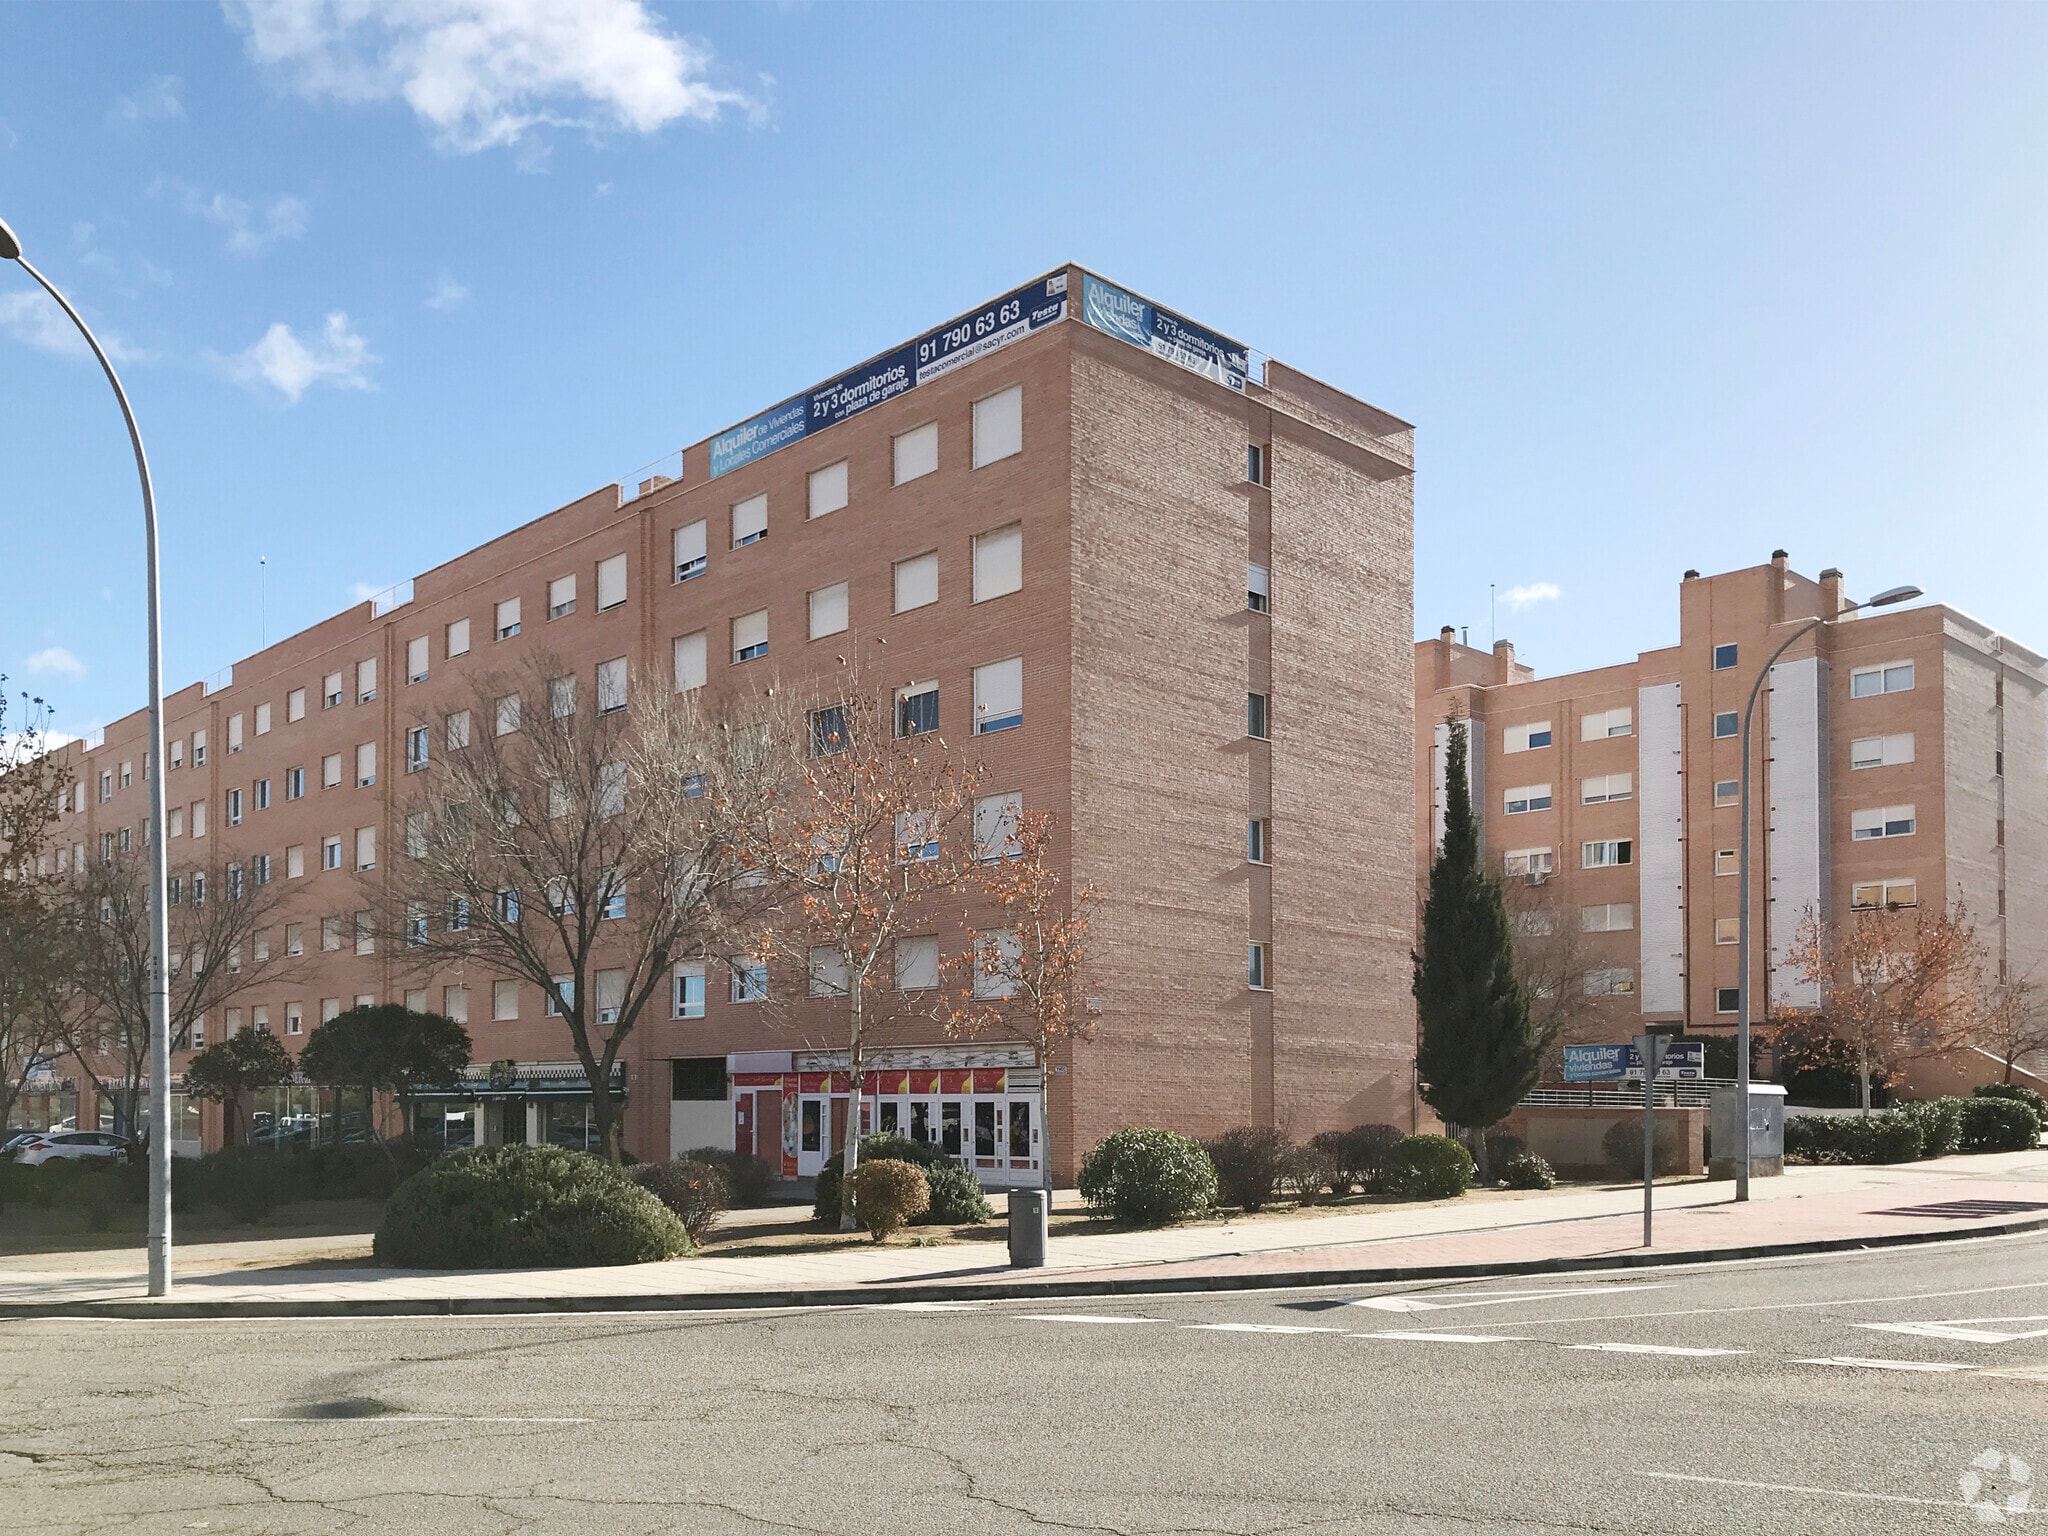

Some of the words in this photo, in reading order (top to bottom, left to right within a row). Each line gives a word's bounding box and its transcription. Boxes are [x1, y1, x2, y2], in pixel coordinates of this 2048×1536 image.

[1031, 303, 1059, 321] Testa
[1088, 283, 1145, 317] Alquiler
[919, 339, 937, 363] 91
[942, 323, 971, 352] 790
[975, 311, 995, 336] 63
[1000, 299, 1020, 324] 63
[1156, 318, 1163, 330] 2
[1163, 323, 1170, 335] y
[1170, 325, 1177, 336] 3
[1177, 328, 1225, 357] dormitorios
[919, 325, 1025, 380] testacomercial@sacyr.com
[813, 402, 821, 418] 2
[822, 400, 830, 417] y
[831, 393, 838, 409] 3
[840, 364, 906, 405] dormitorios
[845, 396, 868, 416] plaza
[869, 390, 881, 403] de
[881, 377, 909, 400] garaje
[713, 423, 759, 458] Alquiler
[758, 425, 768, 436] de
[768, 405, 805, 430] Viviendas
[720, 447, 751, 471] Locales
[751, 420, 805, 452] Comerciales
[1569, 1048, 1620, 1064] Alquiler
[1569, 1061, 1613, 1071] viviendas
